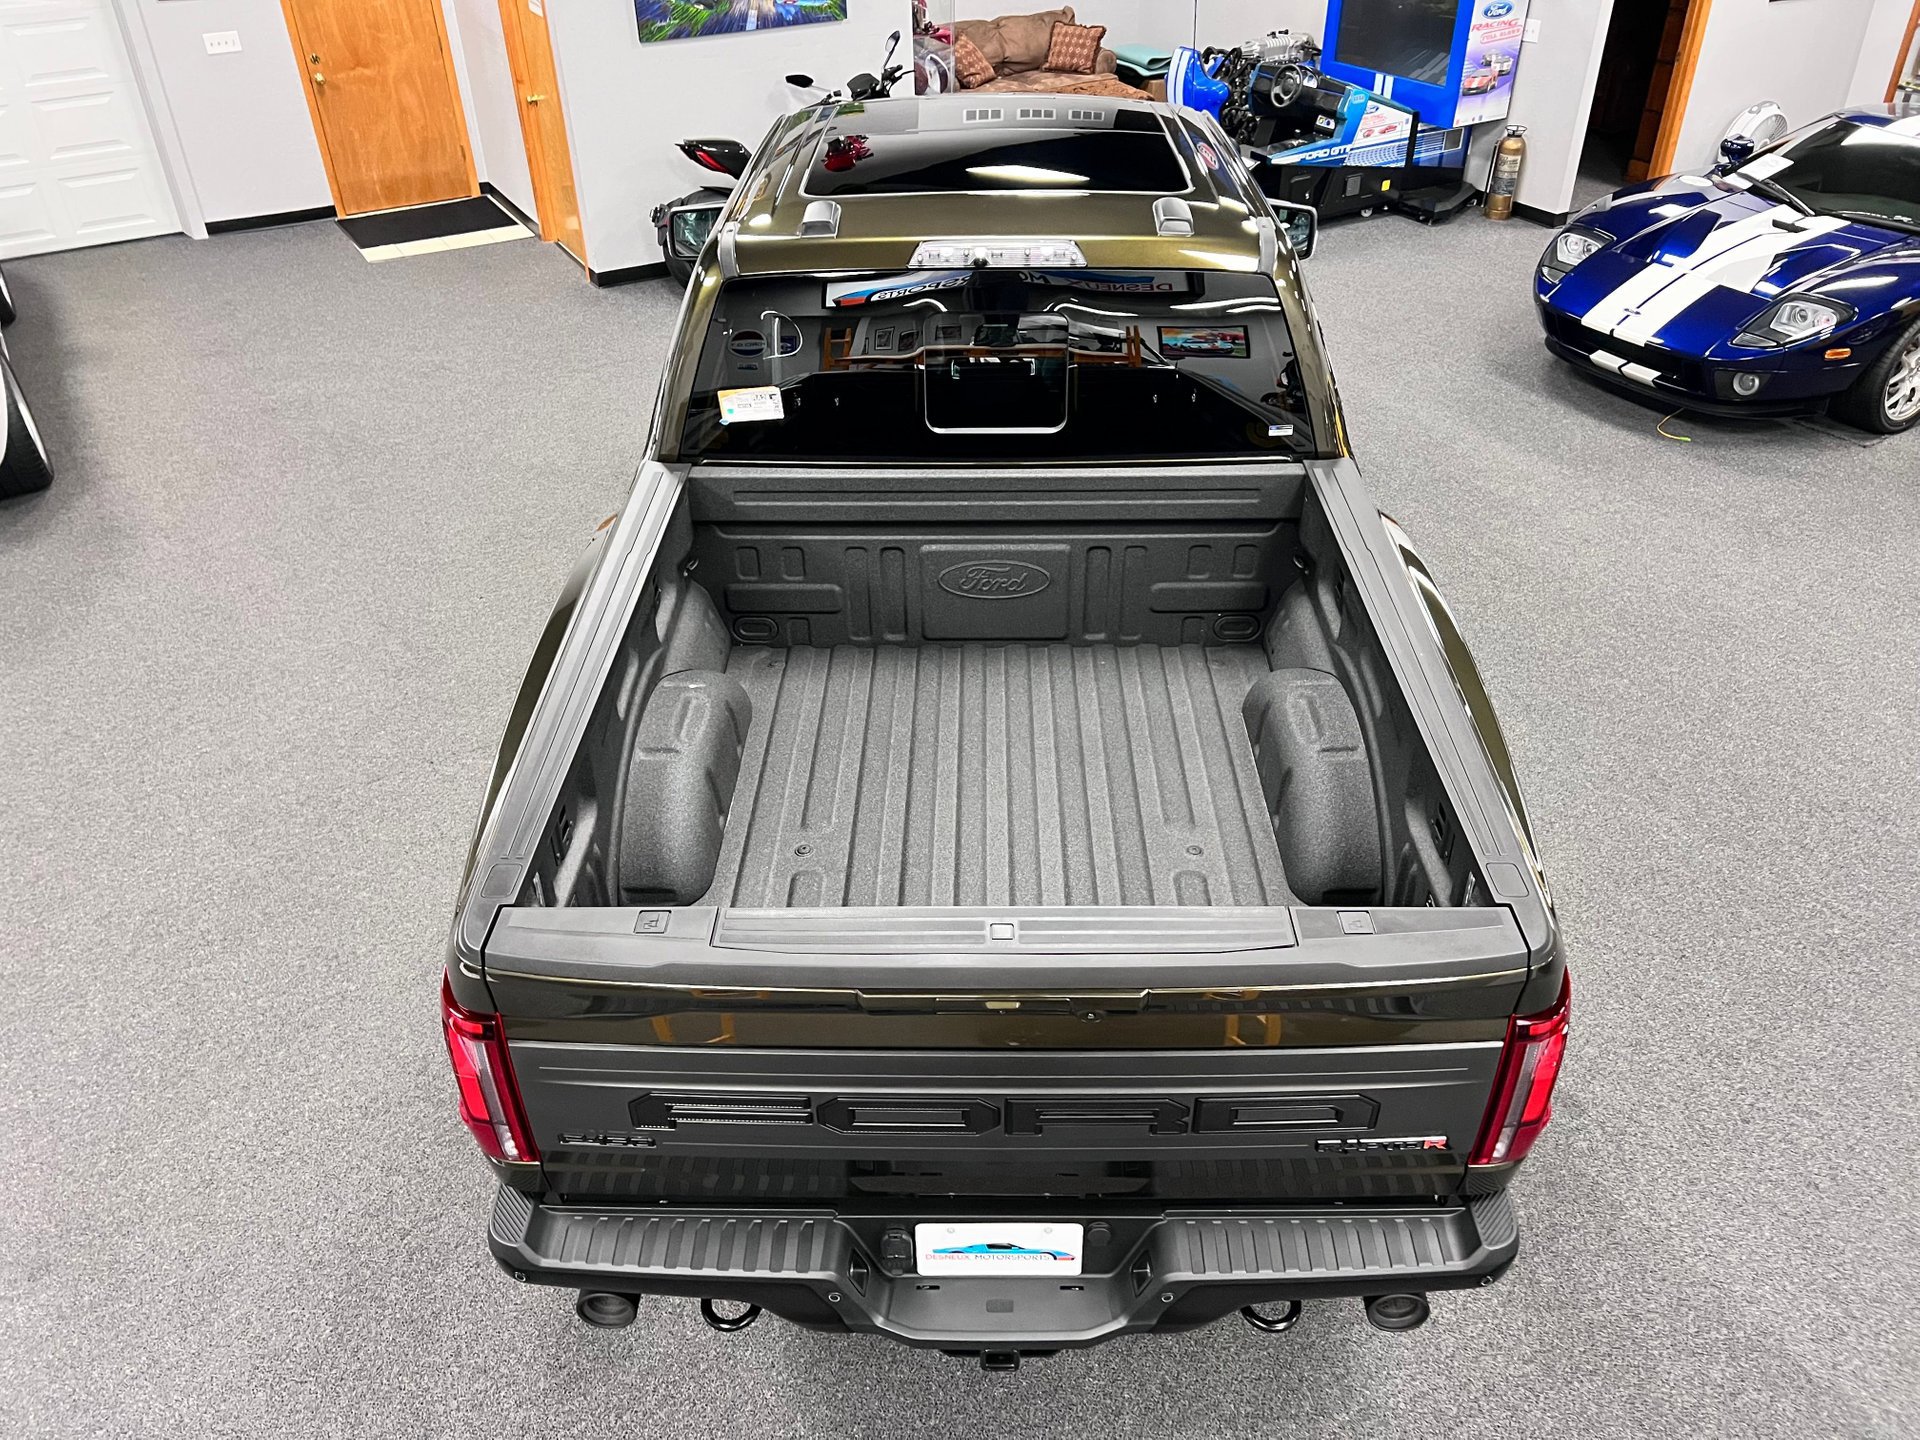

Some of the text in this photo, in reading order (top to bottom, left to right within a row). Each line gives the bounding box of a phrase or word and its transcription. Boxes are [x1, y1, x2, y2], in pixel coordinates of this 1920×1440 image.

[1487, 4, 1509, 17] Ford
[1471, 18, 1520, 32] RACING
[1300, 149, 1330, 160] FORD
[960, 566, 1028, 591] Ford
[628, 1091, 1381, 1136] FORD
[925, 1253, 1051, 1261] DESNEUX MOTORSPORTS
